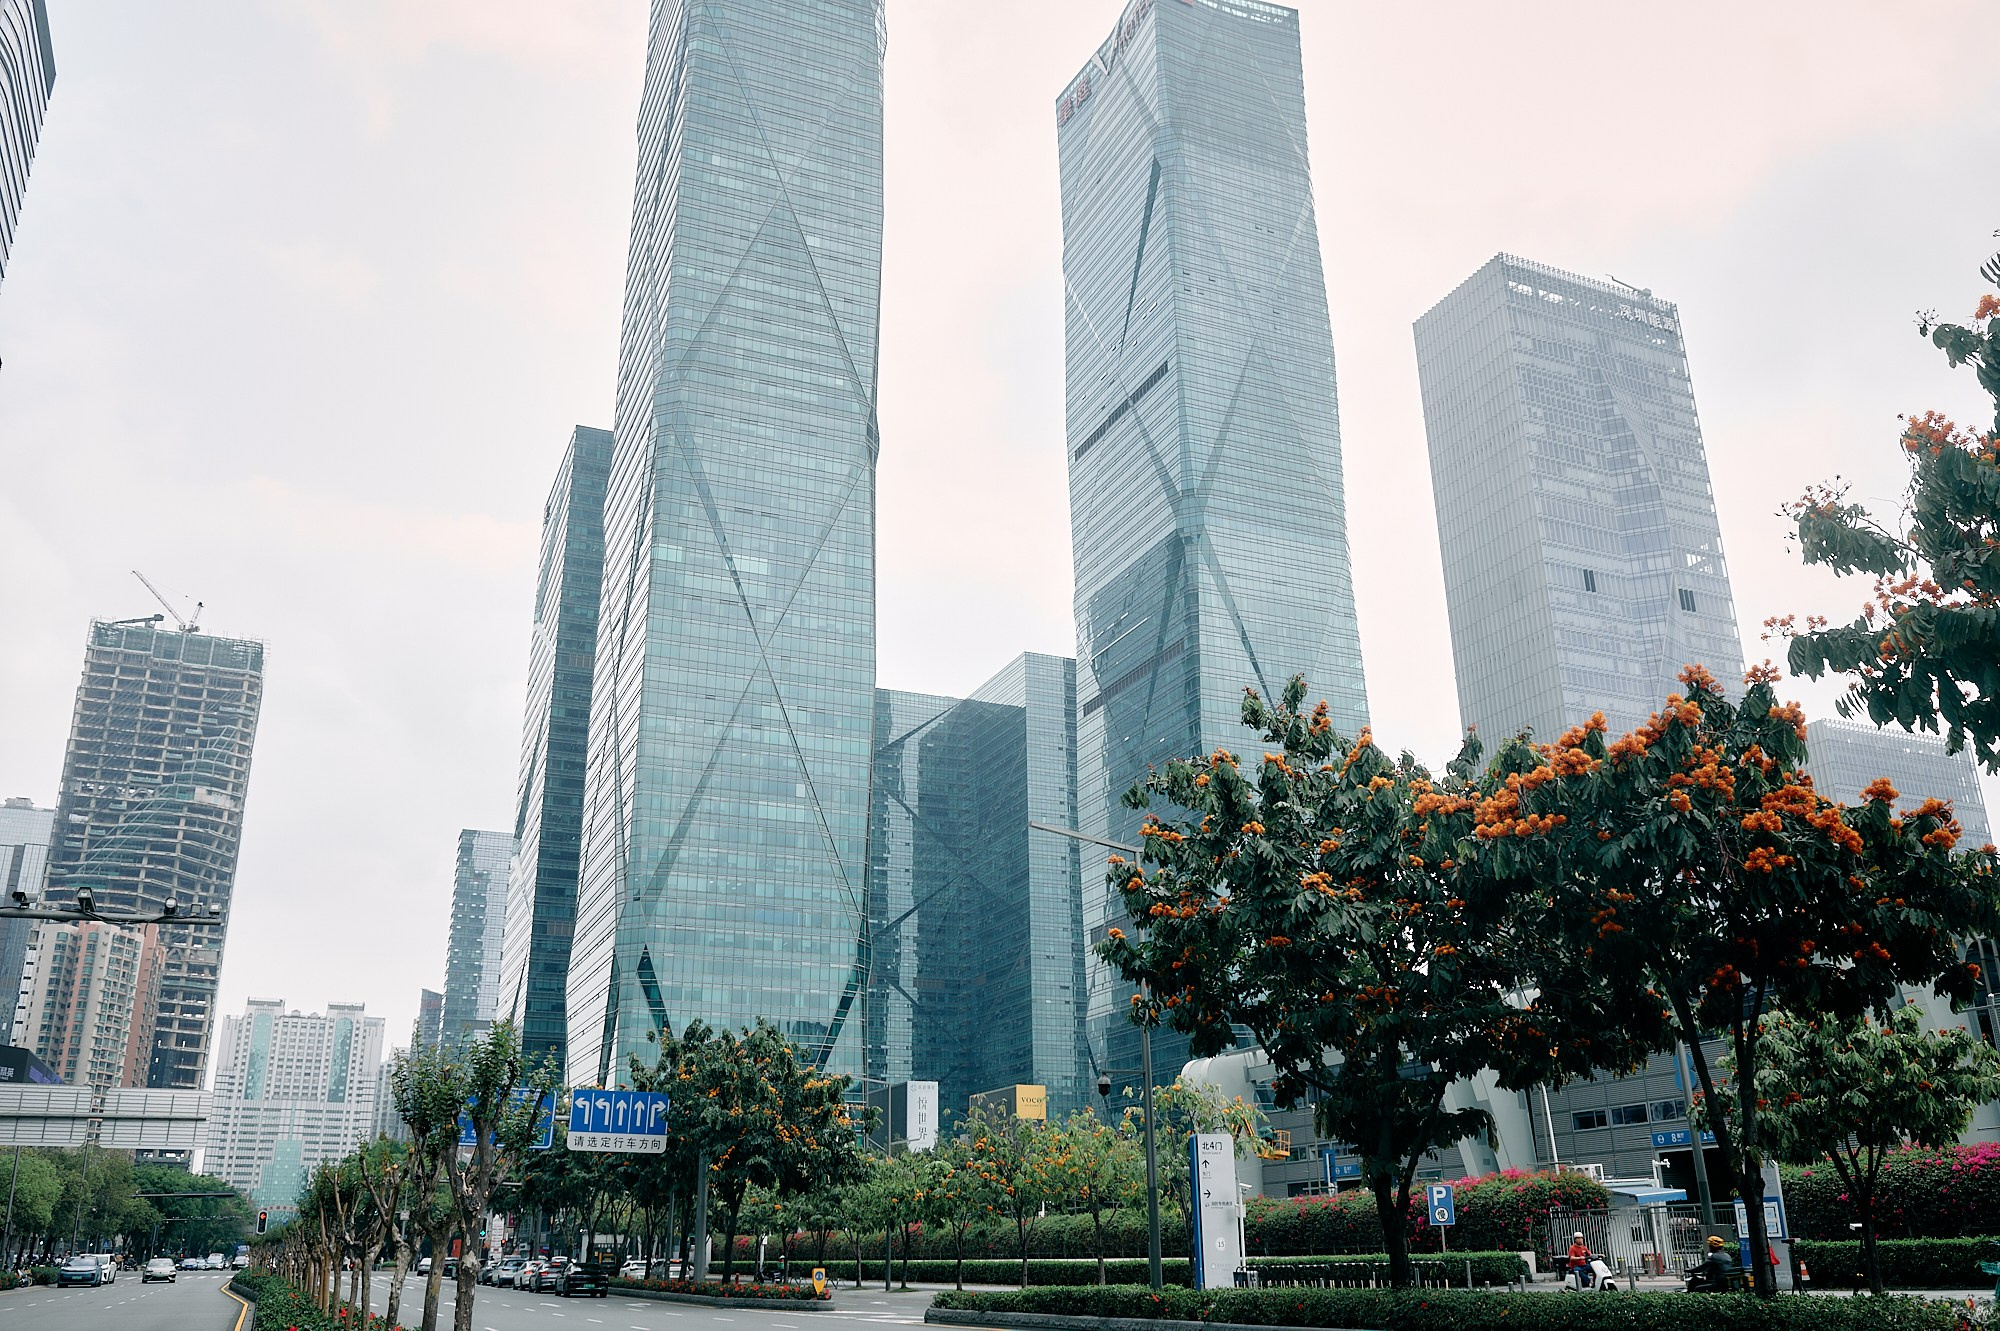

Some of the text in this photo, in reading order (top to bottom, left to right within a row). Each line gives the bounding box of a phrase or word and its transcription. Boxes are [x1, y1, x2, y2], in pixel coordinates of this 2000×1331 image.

[1619, 303, 1676, 331] 深圳能源
[918, 1096, 927, 1140] 悦世界
[574, 1136, 661, 1150] 请选定行车方向
[1202, 1141, 1223, 1151] 北4门
[1432, 1187, 1447, 1206] P
